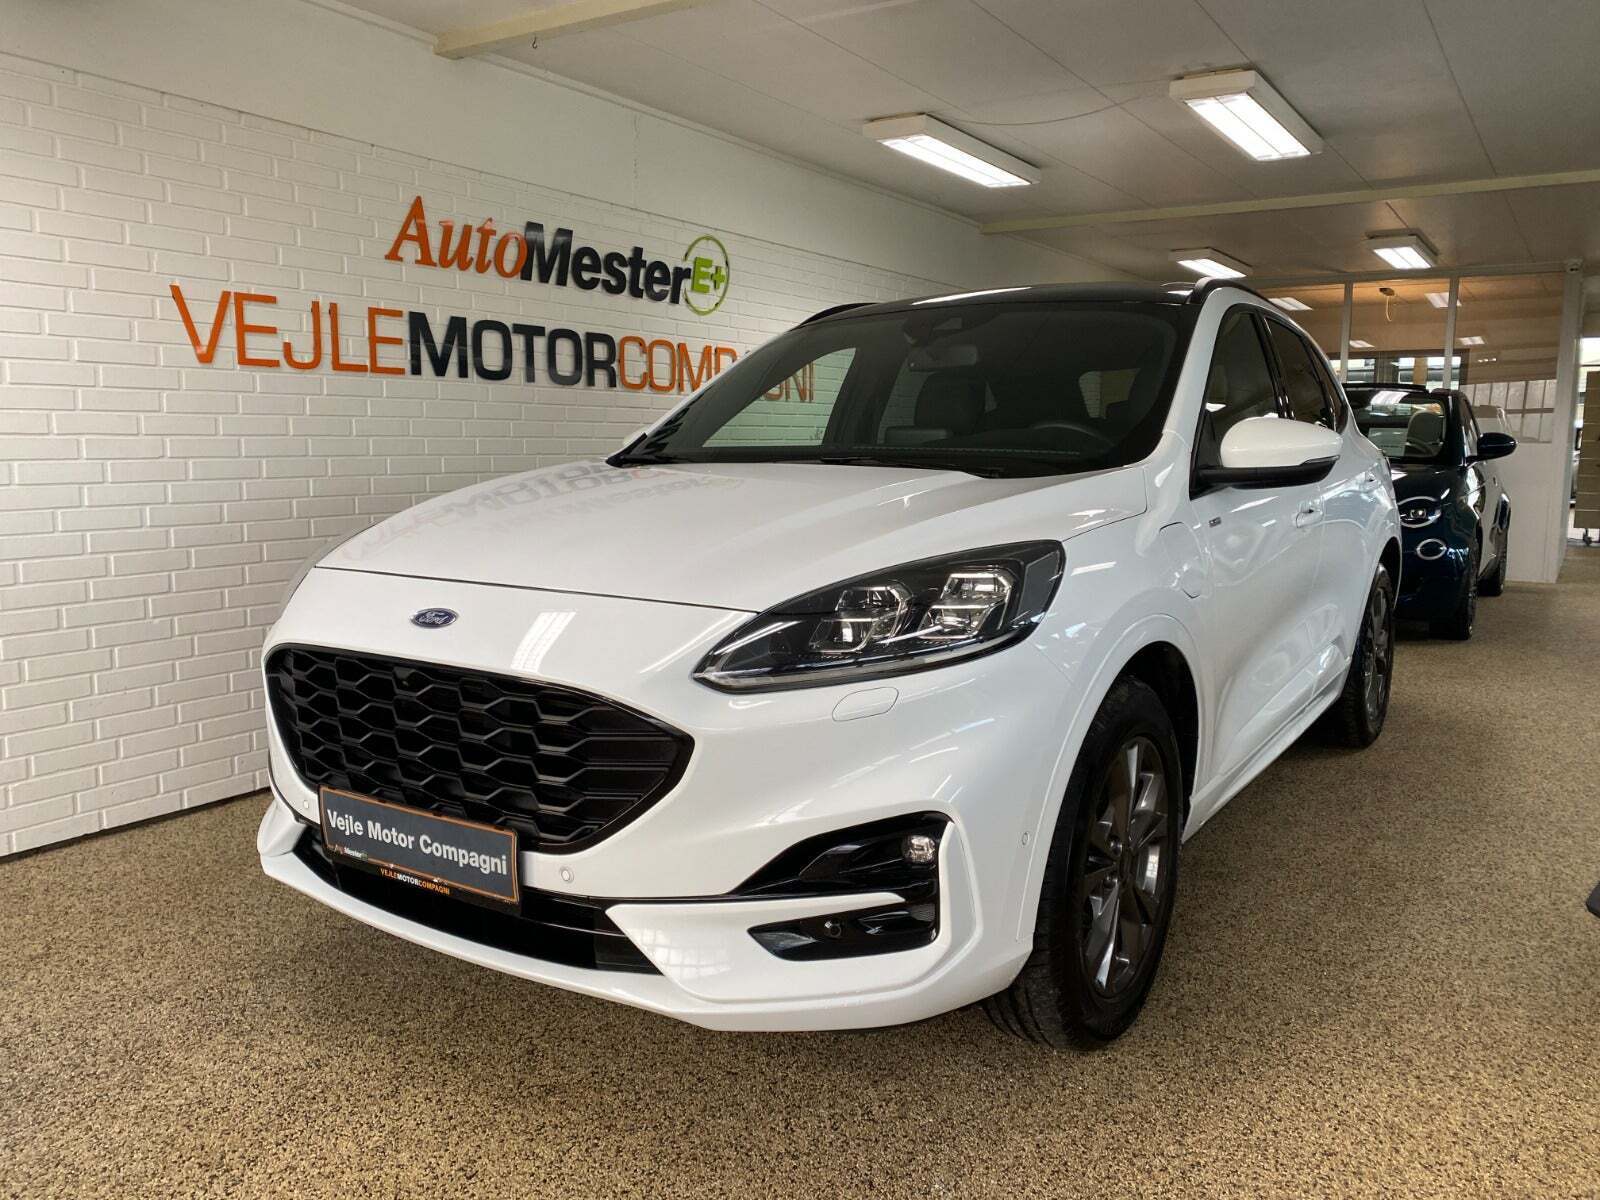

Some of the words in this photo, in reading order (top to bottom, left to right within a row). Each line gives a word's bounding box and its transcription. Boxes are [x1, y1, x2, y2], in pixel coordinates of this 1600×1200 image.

[384, 195, 692, 305] AutoMester
[417, 610, 450, 625] Ford
[326, 808, 364, 837] Vejle
[367, 819, 415, 850] Motor
[419, 834, 508, 876] Compagni
